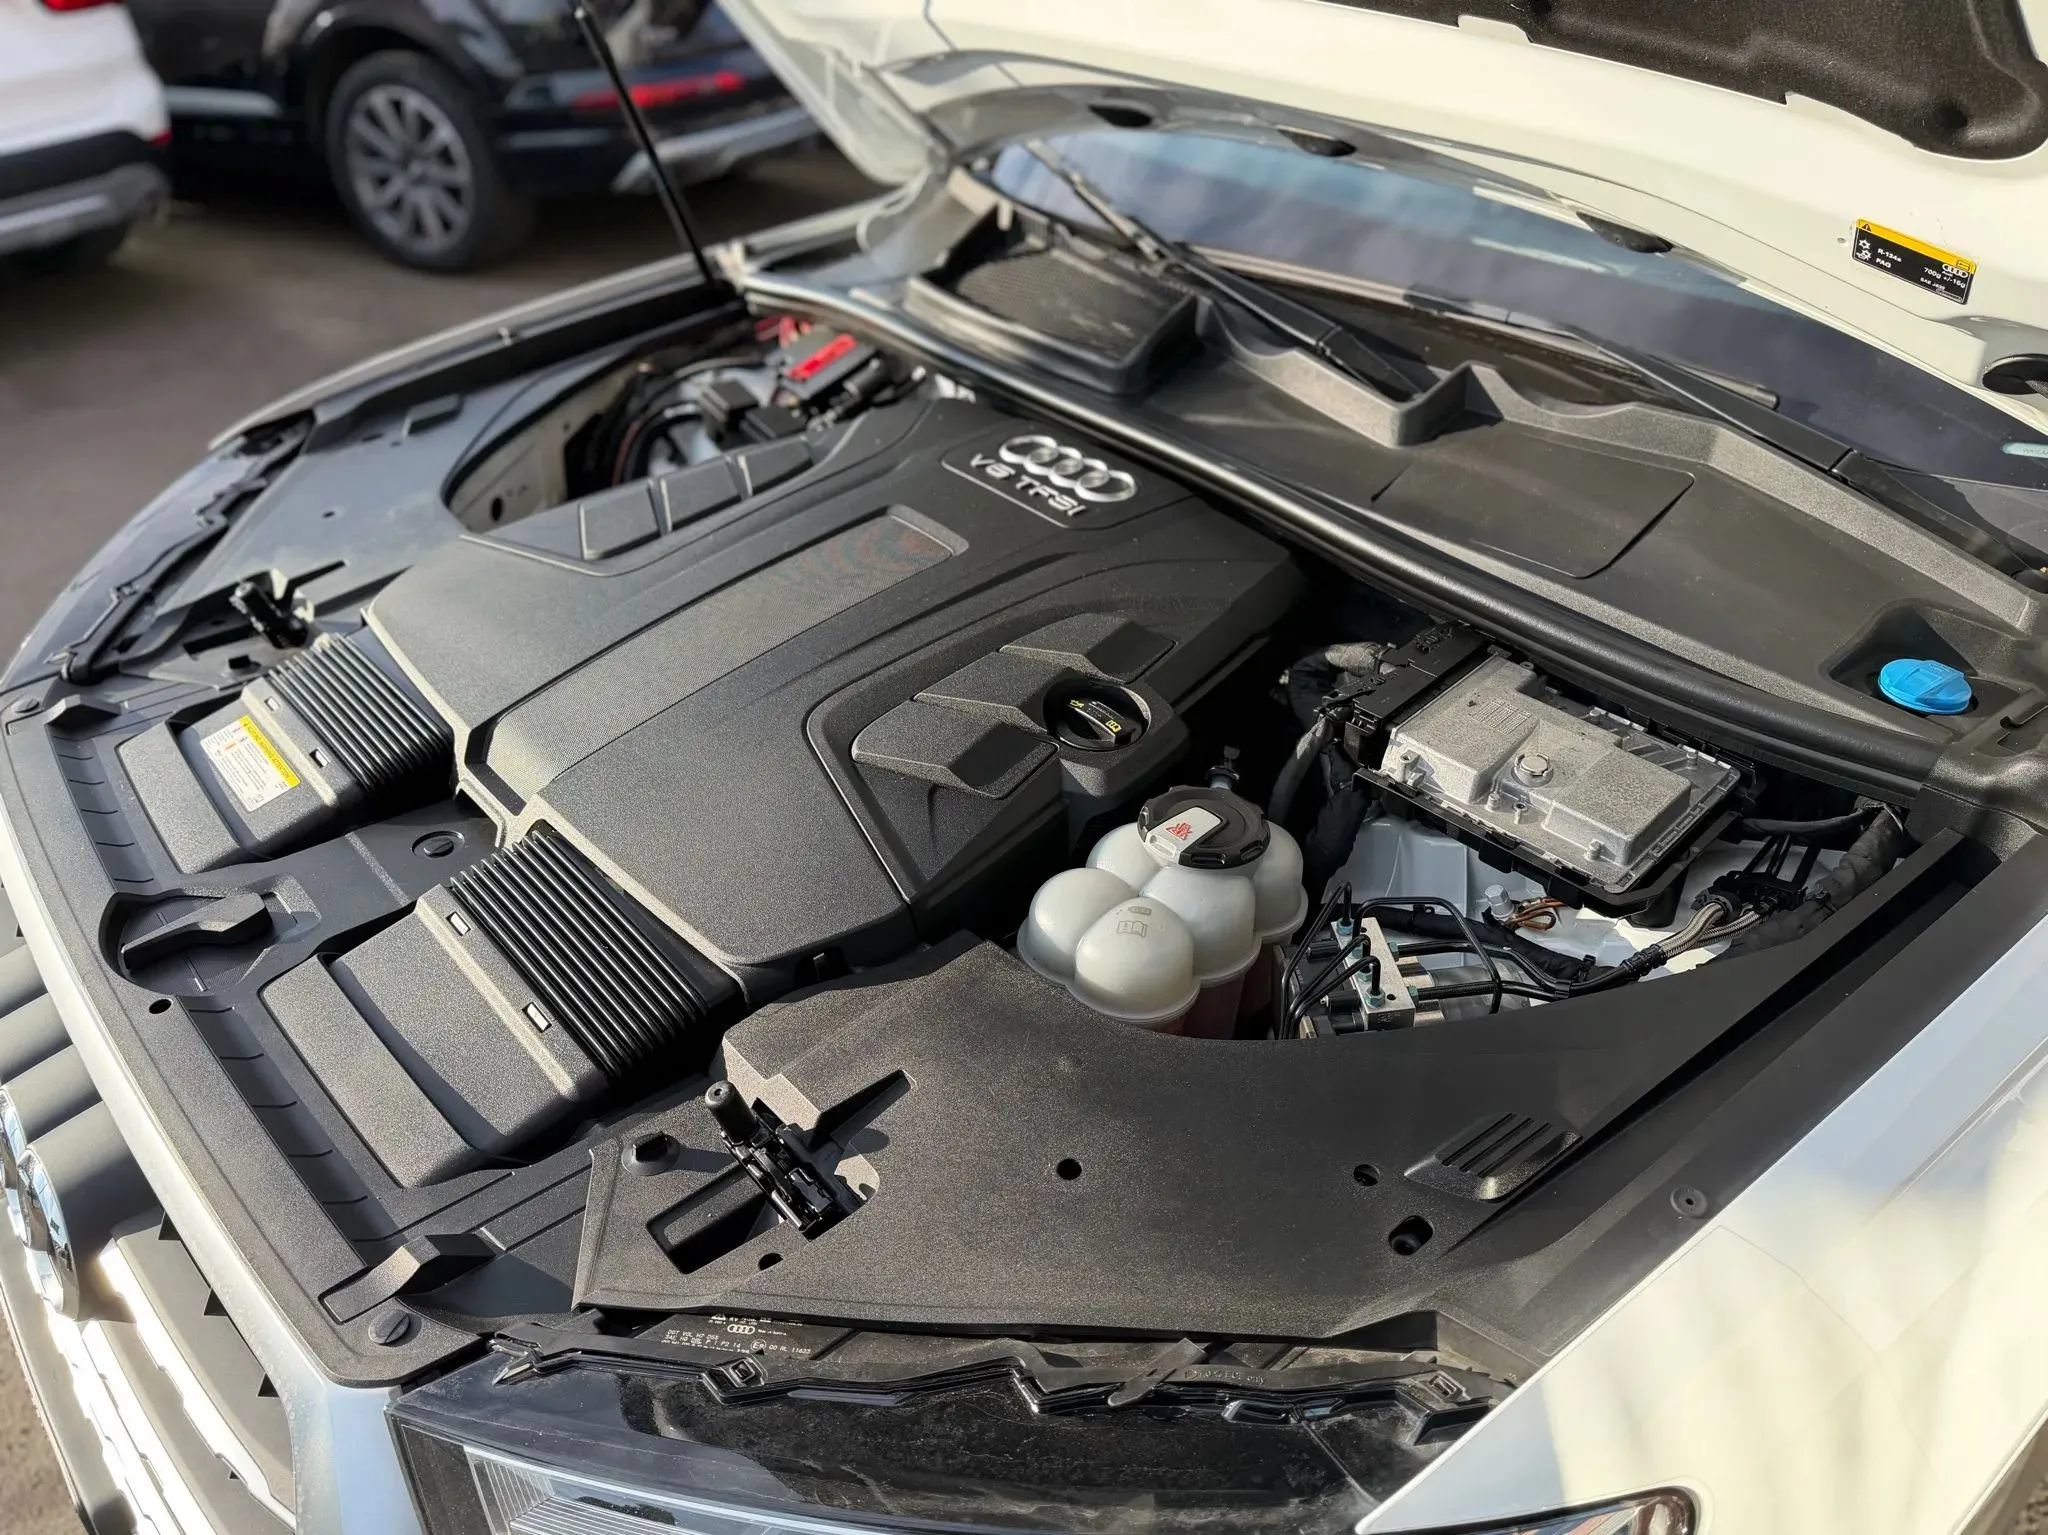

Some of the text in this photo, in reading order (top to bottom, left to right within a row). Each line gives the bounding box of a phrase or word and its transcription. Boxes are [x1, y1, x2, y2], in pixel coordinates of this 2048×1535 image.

[1877, 248, 1902, 262] R-134a
[1924, 267, 1941, 279] 700g
[970, 453, 1087, 517] V6 TFSI
